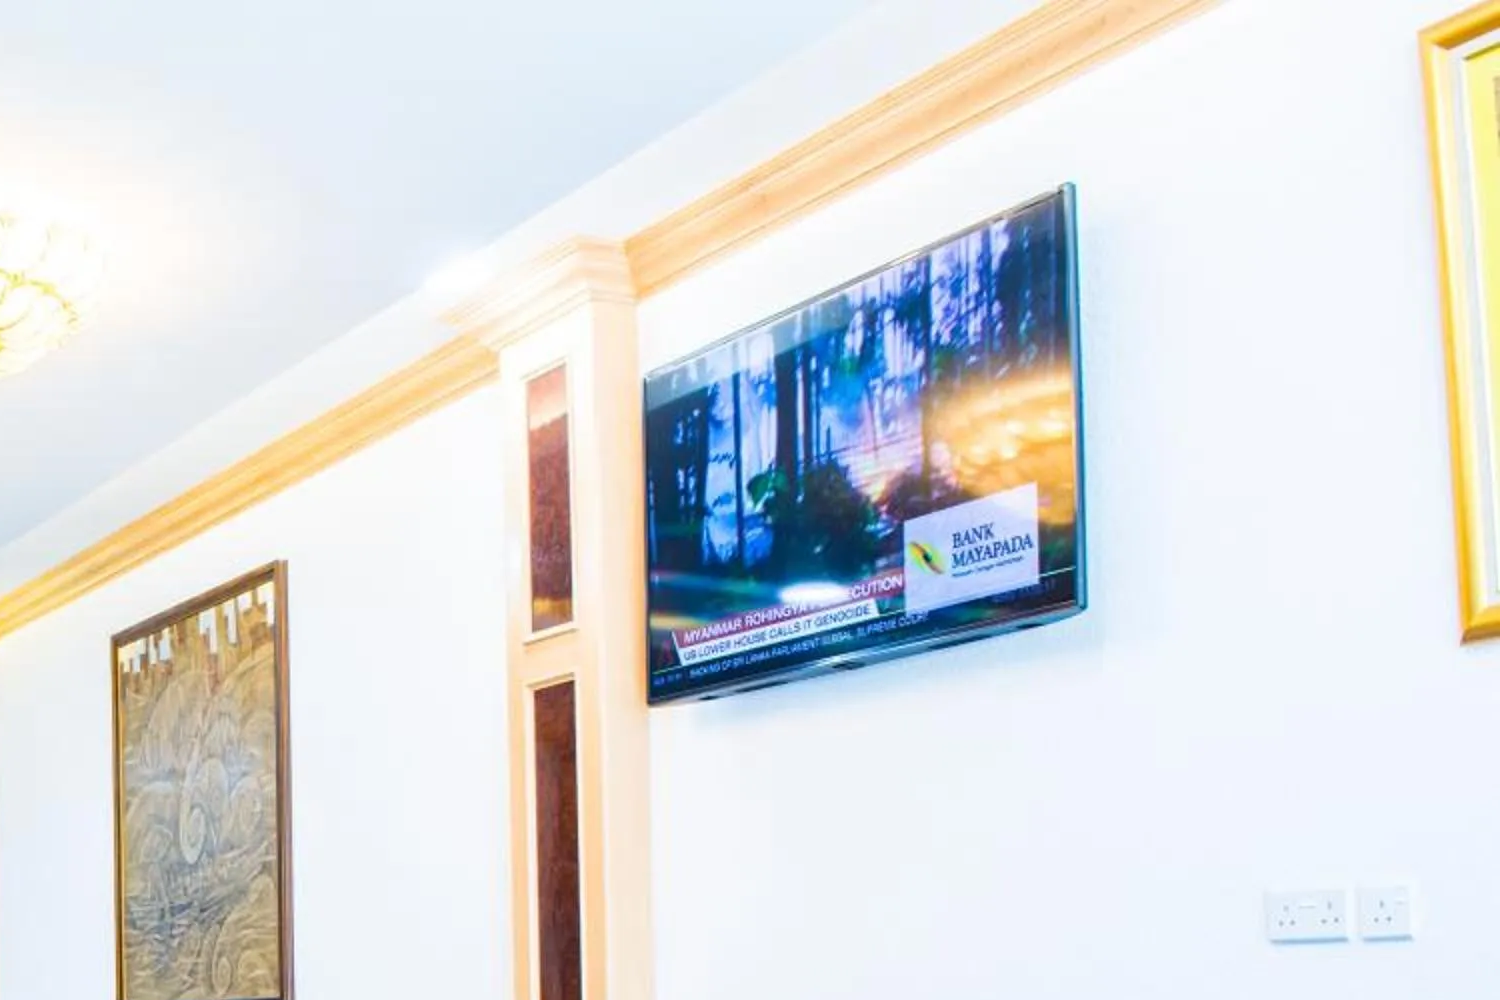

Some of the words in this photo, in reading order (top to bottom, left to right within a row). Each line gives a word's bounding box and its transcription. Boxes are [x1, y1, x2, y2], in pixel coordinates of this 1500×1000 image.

[952, 521, 995, 549] BANK
[952, 533, 1034, 569] MAYAPADA
[683, 617, 742, 644] MYANMAR
[700, 640, 731, 657] LOWER
[734, 633, 767, 648] HOUSE
[770, 621, 801, 639] CALLS
[803, 618, 812, 631] IT
[814, 603, 871, 627] GENOCIDE
